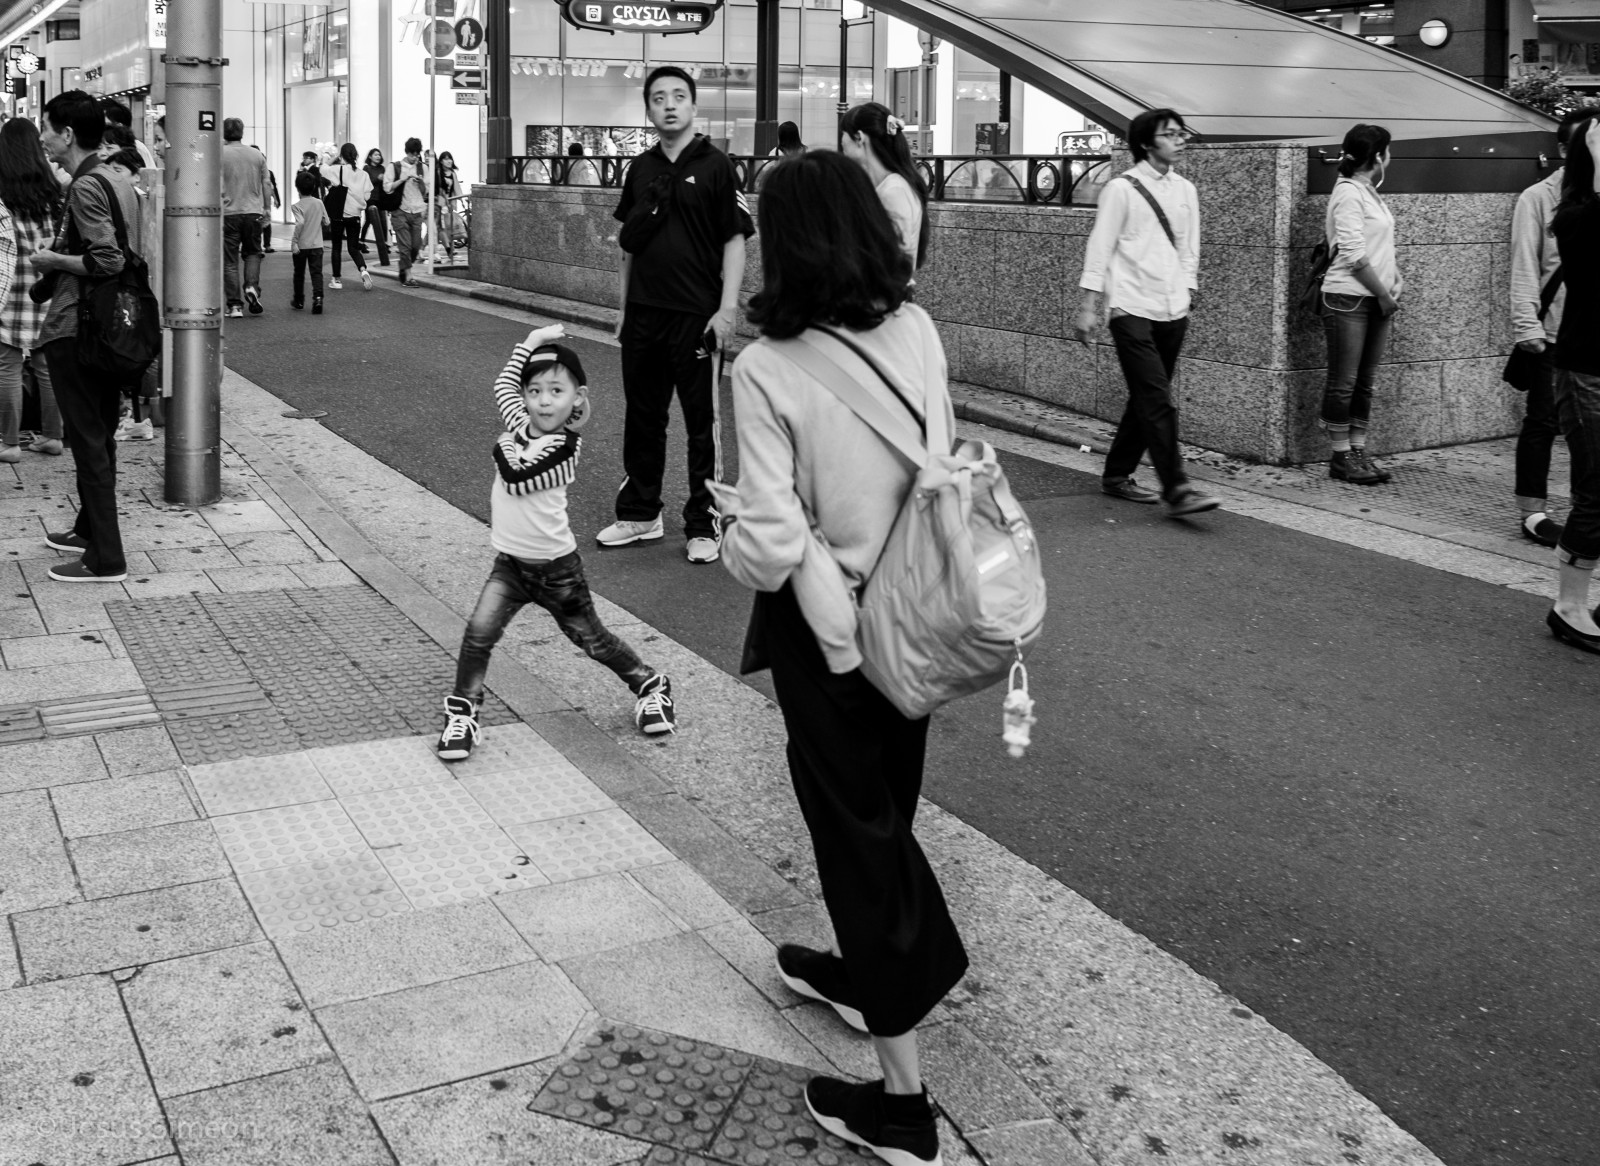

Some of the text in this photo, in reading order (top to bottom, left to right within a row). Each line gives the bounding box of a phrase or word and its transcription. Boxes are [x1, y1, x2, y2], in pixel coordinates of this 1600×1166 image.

[612, 5, 671, 21] CRYSTA
[676, 12, 702, 22] 地下街
